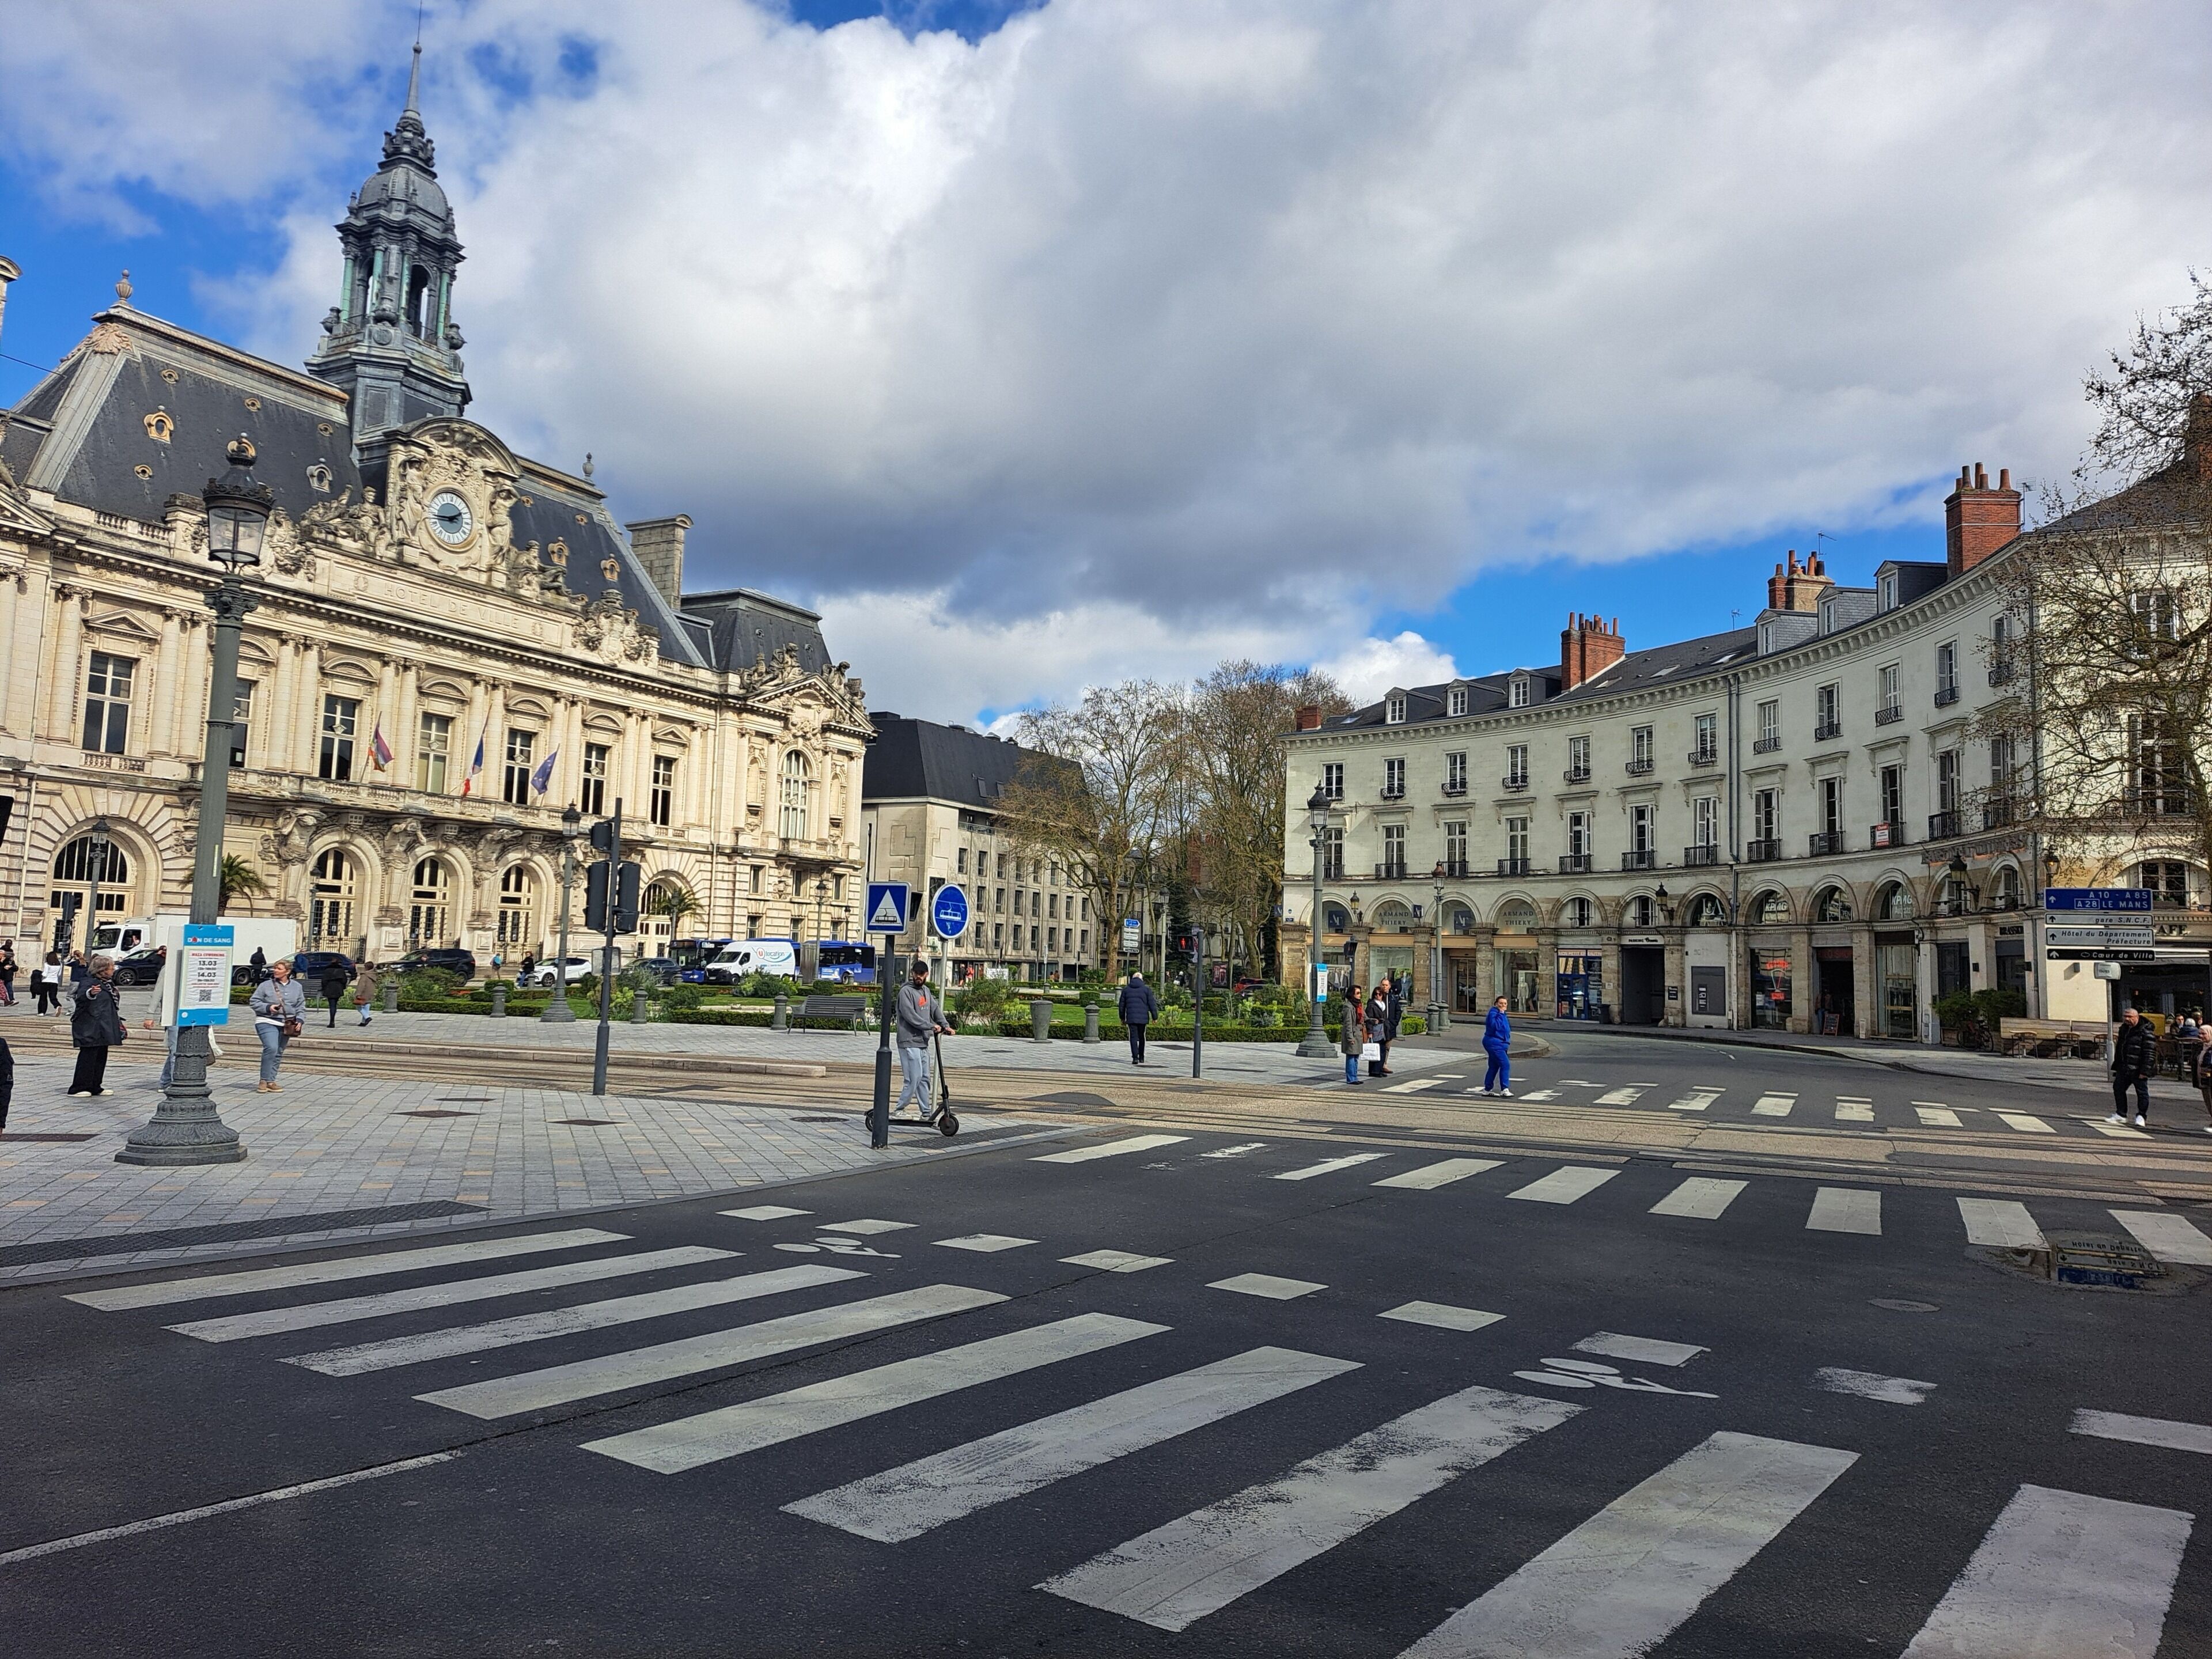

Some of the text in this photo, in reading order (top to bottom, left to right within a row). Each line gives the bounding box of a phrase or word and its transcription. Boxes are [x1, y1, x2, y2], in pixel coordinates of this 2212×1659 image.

[384, 582, 519, 628] HOTEL DE VILLE
[1892, 895, 1912, 905] KPMG
